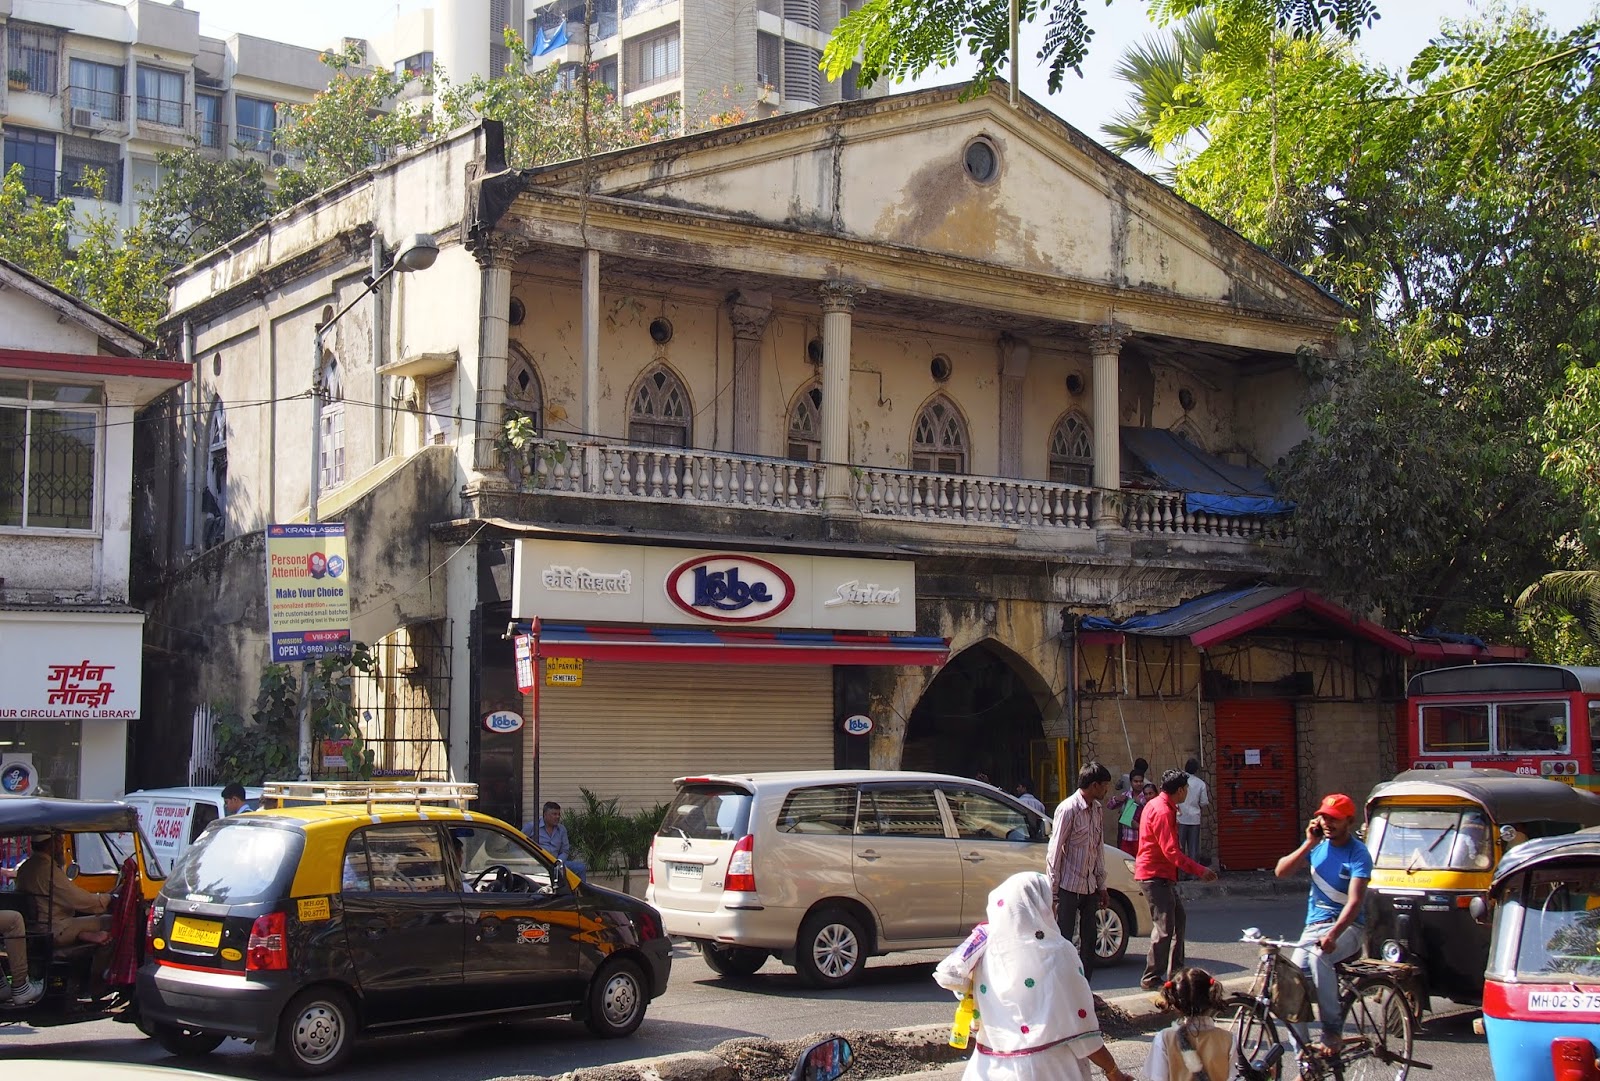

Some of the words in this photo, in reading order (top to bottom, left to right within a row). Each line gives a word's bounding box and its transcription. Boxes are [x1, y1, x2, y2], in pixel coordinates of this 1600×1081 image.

[271, 553, 309, 565] Personal
[272, 567, 310, 578] Attention
[276, 588, 297, 599] Make
[298, 588, 316, 598] Your
[316, 586, 344, 597] Choice
[279, 646, 299, 656] OPEN
[0, 709, 17, 718] UR
[20, 709, 90, 718] CIRCULATING
[92, 709, 137, 718] LIBRARY
